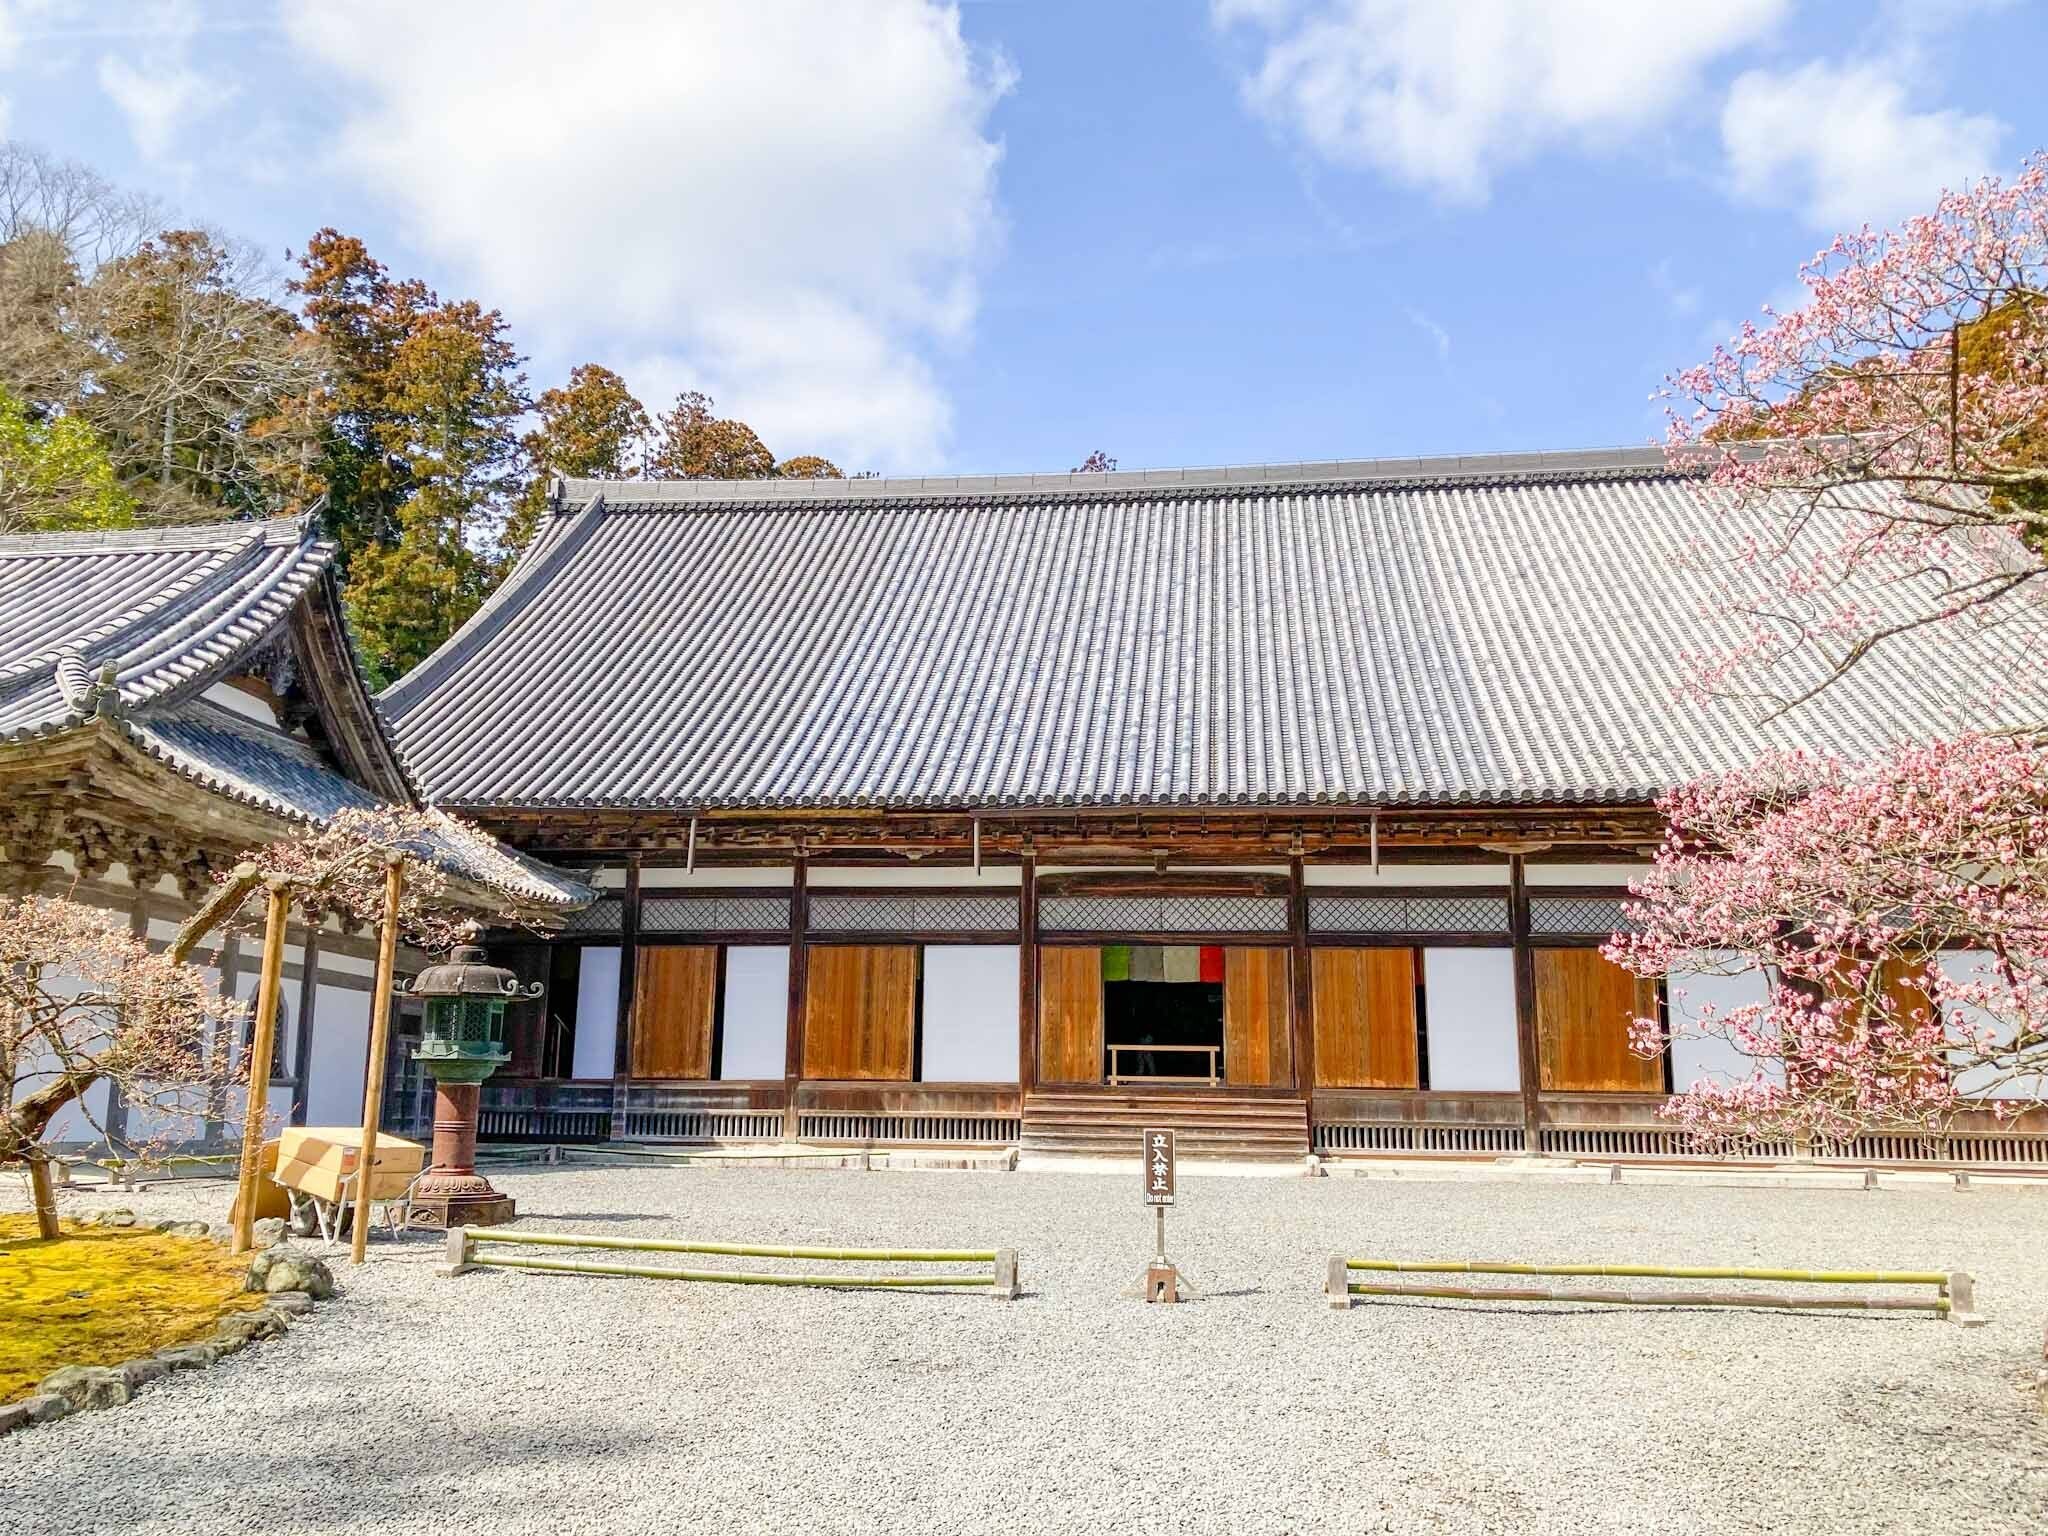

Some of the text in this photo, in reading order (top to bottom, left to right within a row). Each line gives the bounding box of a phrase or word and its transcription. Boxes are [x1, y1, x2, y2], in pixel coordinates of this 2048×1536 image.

[1152, 1134, 1168, 1190] 立入禁止
[1147, 1192, 1153, 1202] Do
[1162, 1193, 1173, 1202] enter
